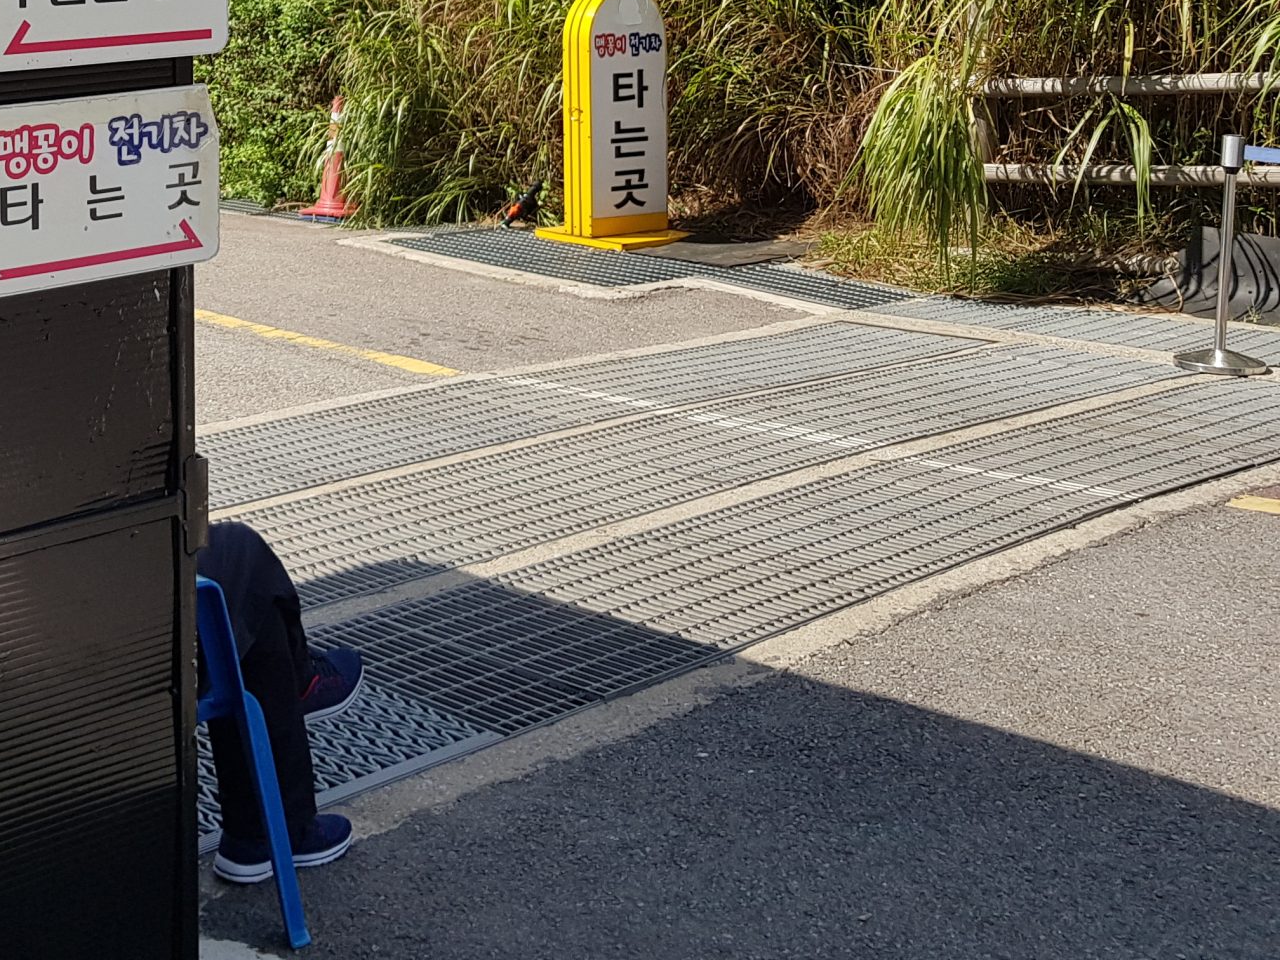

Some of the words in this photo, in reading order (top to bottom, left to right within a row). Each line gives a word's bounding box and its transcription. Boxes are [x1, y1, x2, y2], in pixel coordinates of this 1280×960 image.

[593, 32, 627, 58] 맹꽁이
[628, 32, 662, 57] 전기차
[108, 110, 209, 166] 전기차
